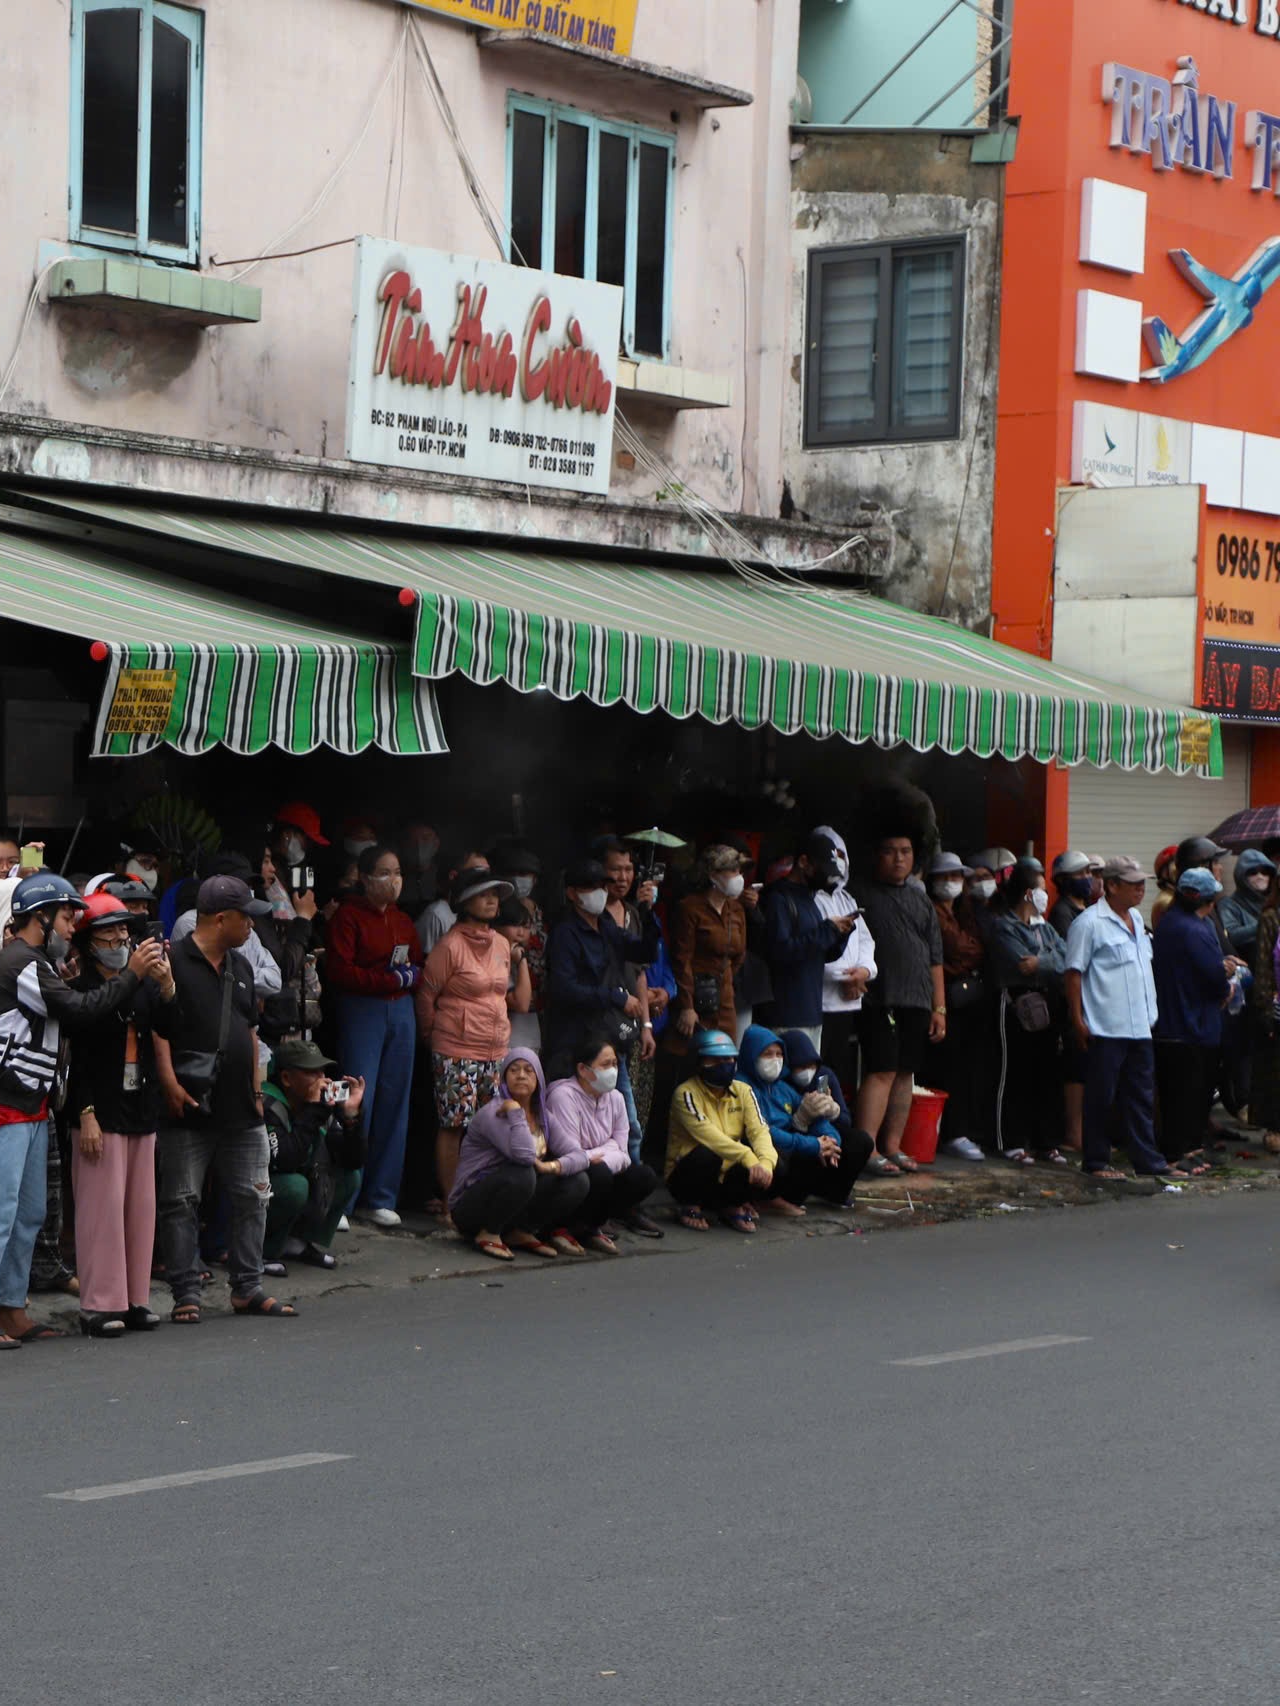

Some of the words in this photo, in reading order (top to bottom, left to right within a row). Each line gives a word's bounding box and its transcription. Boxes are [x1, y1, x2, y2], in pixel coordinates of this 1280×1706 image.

[568, 14, 586, 42] AN
[587, 17, 617, 51] TÁNG
[397, 413, 420, 434] PHẠM
[543, 455, 557, 473] 028
[1217, 532, 1260, 580] 0986
